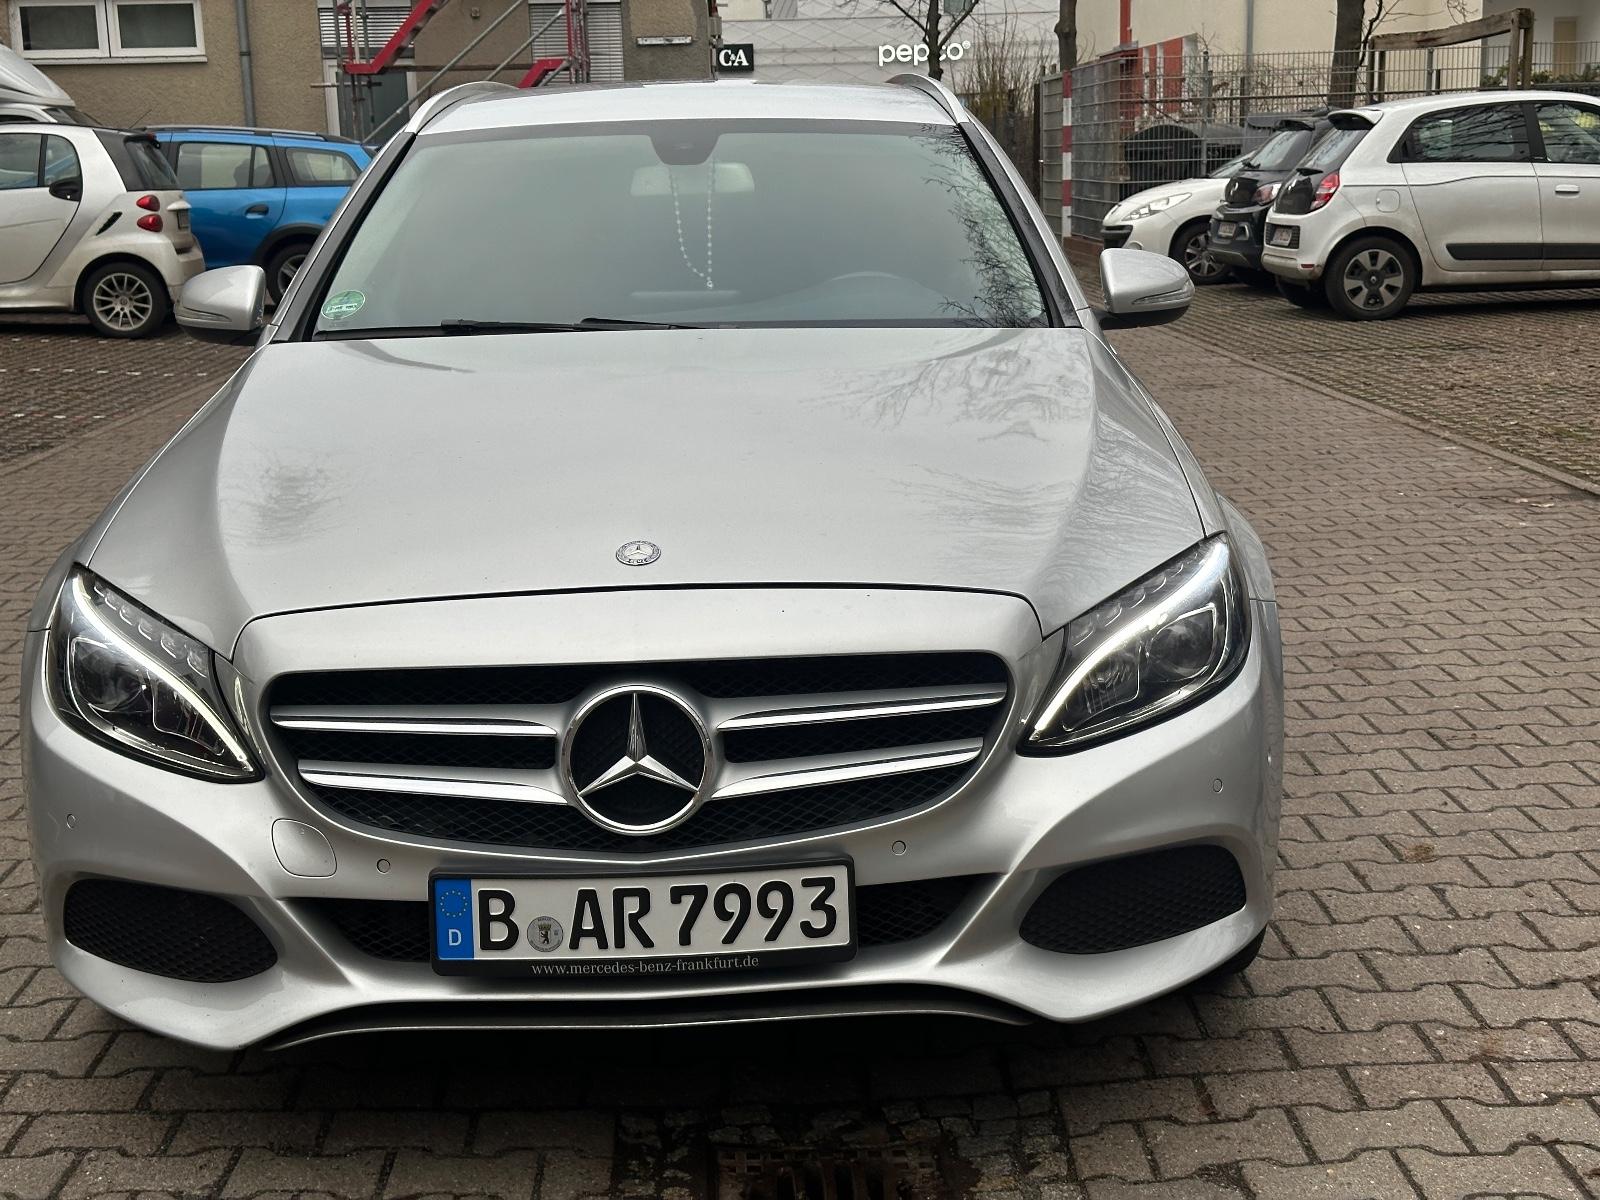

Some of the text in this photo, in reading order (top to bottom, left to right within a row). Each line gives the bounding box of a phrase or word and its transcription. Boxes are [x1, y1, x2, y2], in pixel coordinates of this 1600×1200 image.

[719, 49, 749, 66] C&A
[478, 876, 837, 950] B AR 7993
[448, 929, 462, 946] D
[531, 956, 760, 975] www.mercedes-benz-frankfurt.de
